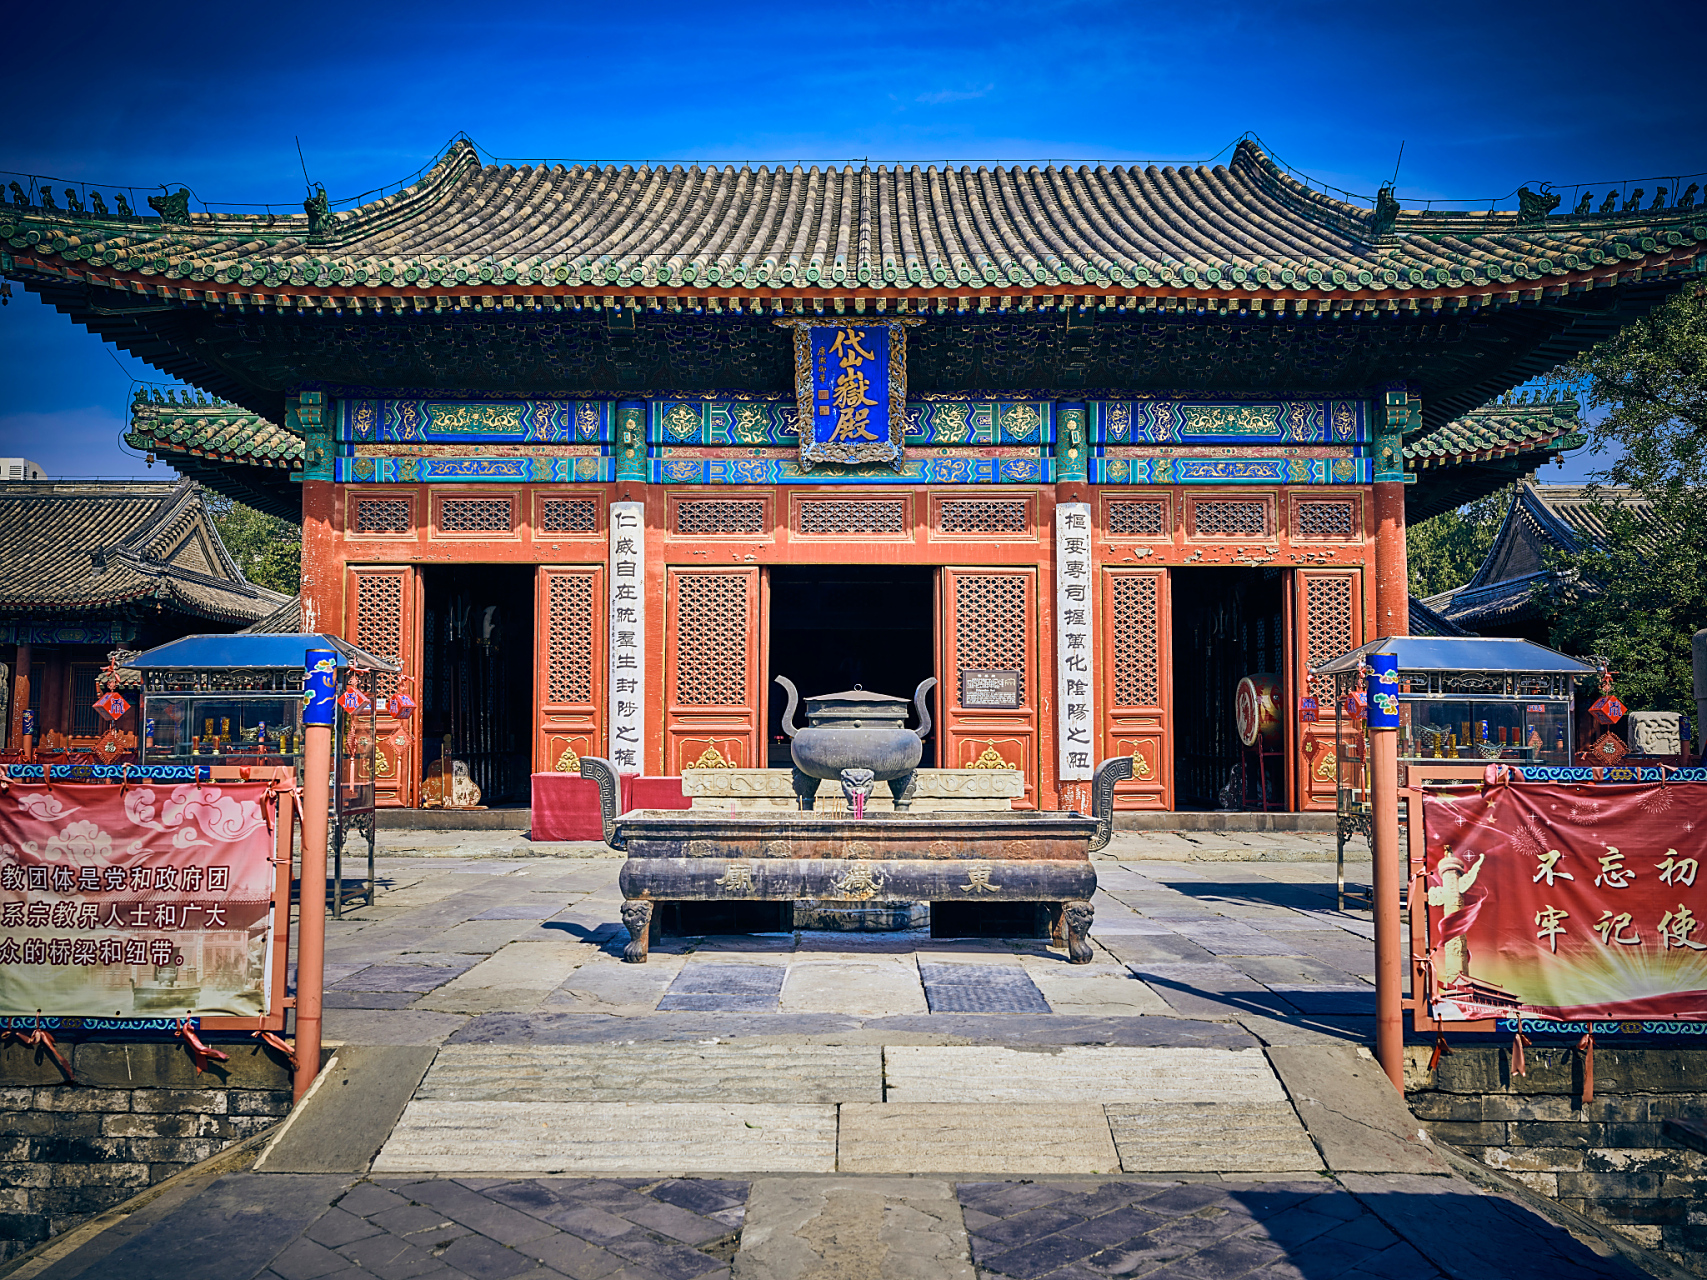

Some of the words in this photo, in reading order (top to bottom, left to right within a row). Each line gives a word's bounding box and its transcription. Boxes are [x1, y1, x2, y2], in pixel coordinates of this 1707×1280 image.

[1, 865, 231, 892] 教团体是党和政府团
[1532, 846, 1699, 888] 不忘初
[1, 900, 227, 929] 系宗教界人士和广大
[1534, 903, 1707, 953] 牢记使
[0, 937, 184, 967] 众的桥梁和纽带。
